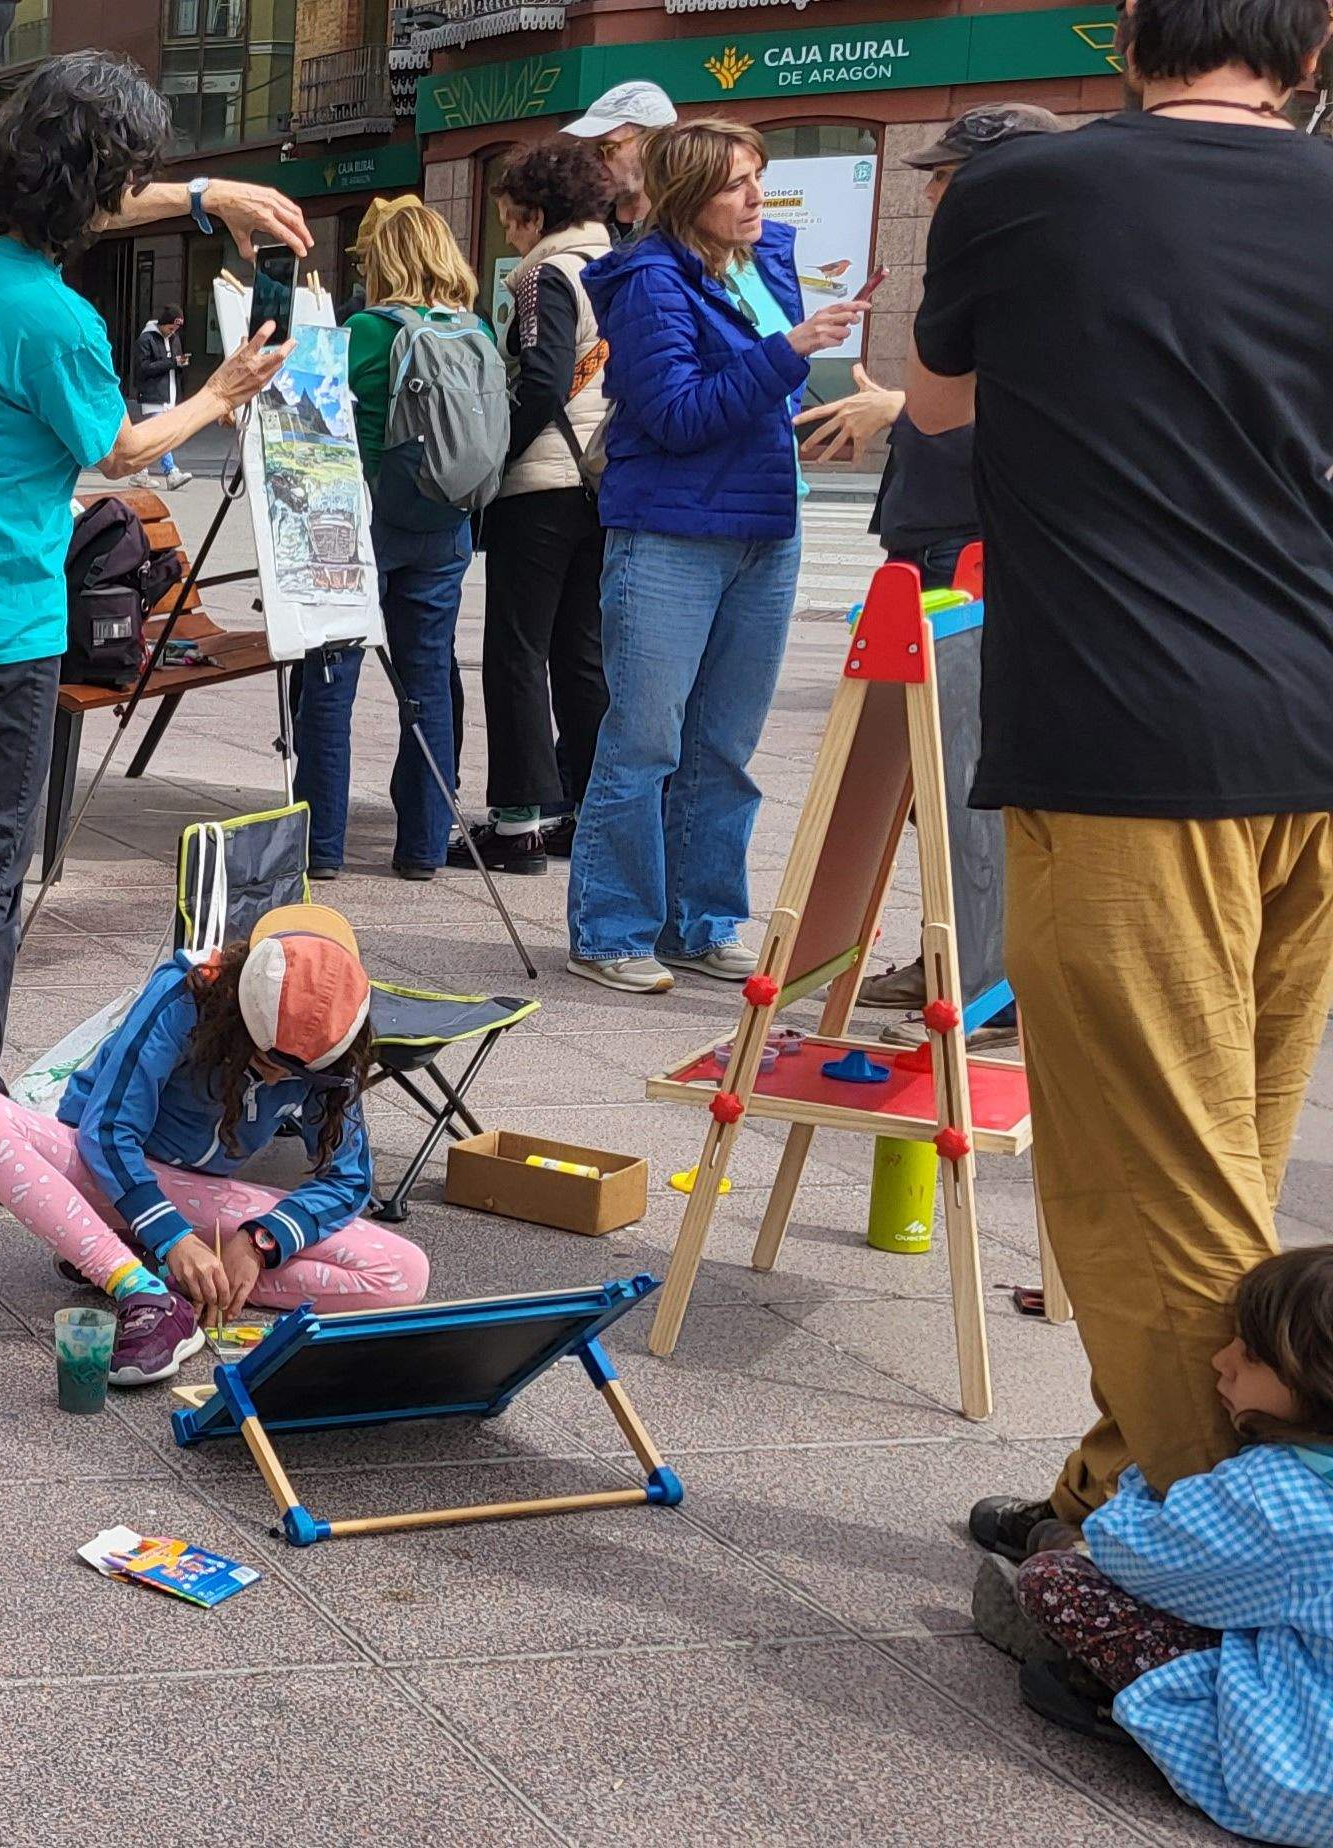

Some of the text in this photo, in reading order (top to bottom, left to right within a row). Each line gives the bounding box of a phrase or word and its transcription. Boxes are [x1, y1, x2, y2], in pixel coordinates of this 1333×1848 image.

[764, 38, 910, 67] CAJA RURAL
[778, 62, 892, 86] DE ARAGÓN
